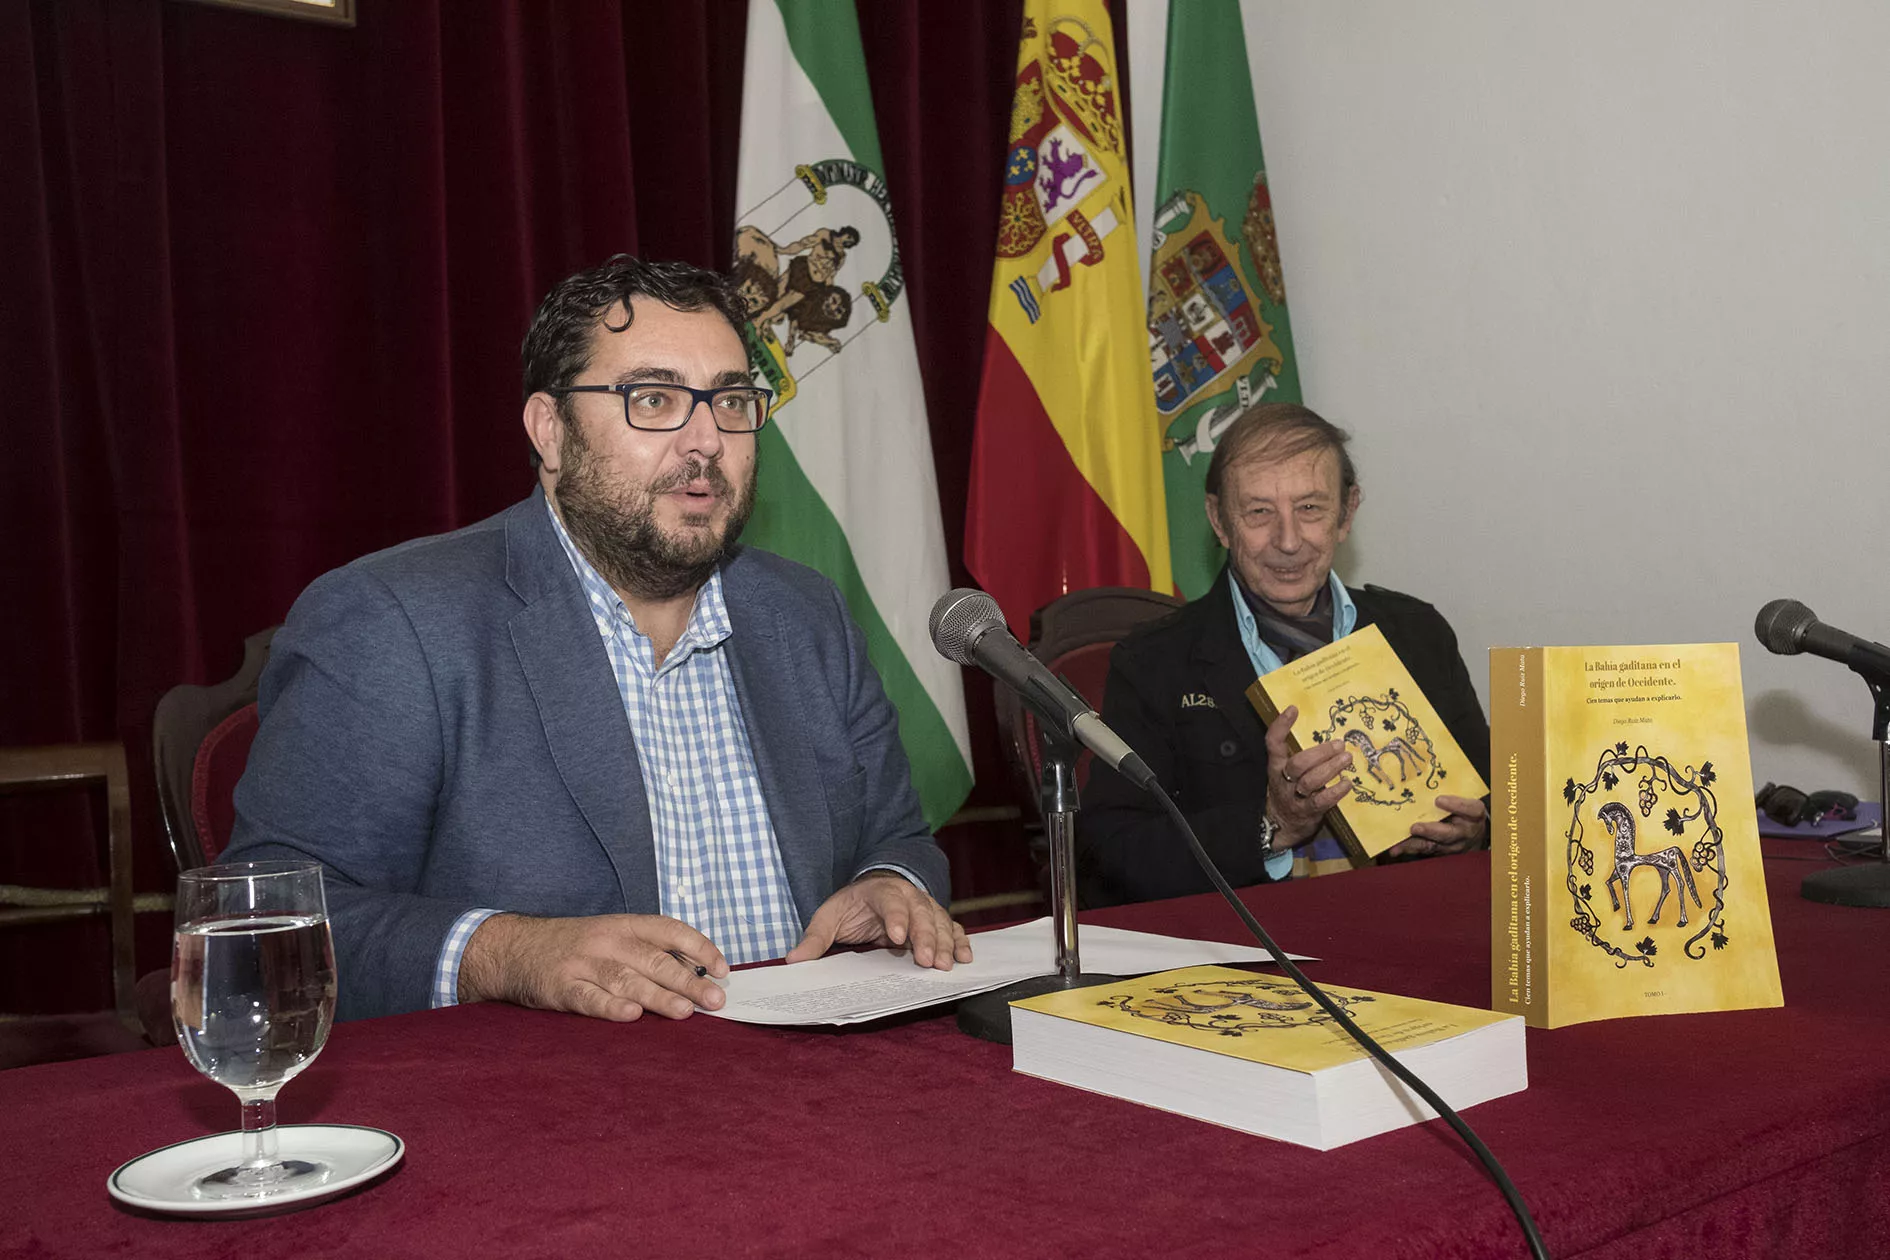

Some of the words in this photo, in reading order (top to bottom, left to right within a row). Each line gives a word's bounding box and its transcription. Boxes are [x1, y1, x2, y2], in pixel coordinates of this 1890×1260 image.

[1585, 662, 1593, 671] La
[1619, 660, 1657, 673] gaditana
[1672, 659, 1681, 669] el
[1589, 678, 1614, 691] origen
[1616, 677, 1626, 688] de
[1628, 676, 1676, 687] Occidente.
[1507, 753, 1518, 814] Occidente.
[1507, 816, 1518, 830] de
[1508, 832, 1520, 870] origen
[1508, 871, 1518, 882] el
[1510, 884, 1518, 899] en
[1524, 876, 1532, 914] explicarlo.
[1508, 900, 1520, 951] gaditana
[1524, 922, 1532, 948] ayudan
[1509, 989, 1519, 1003] La
